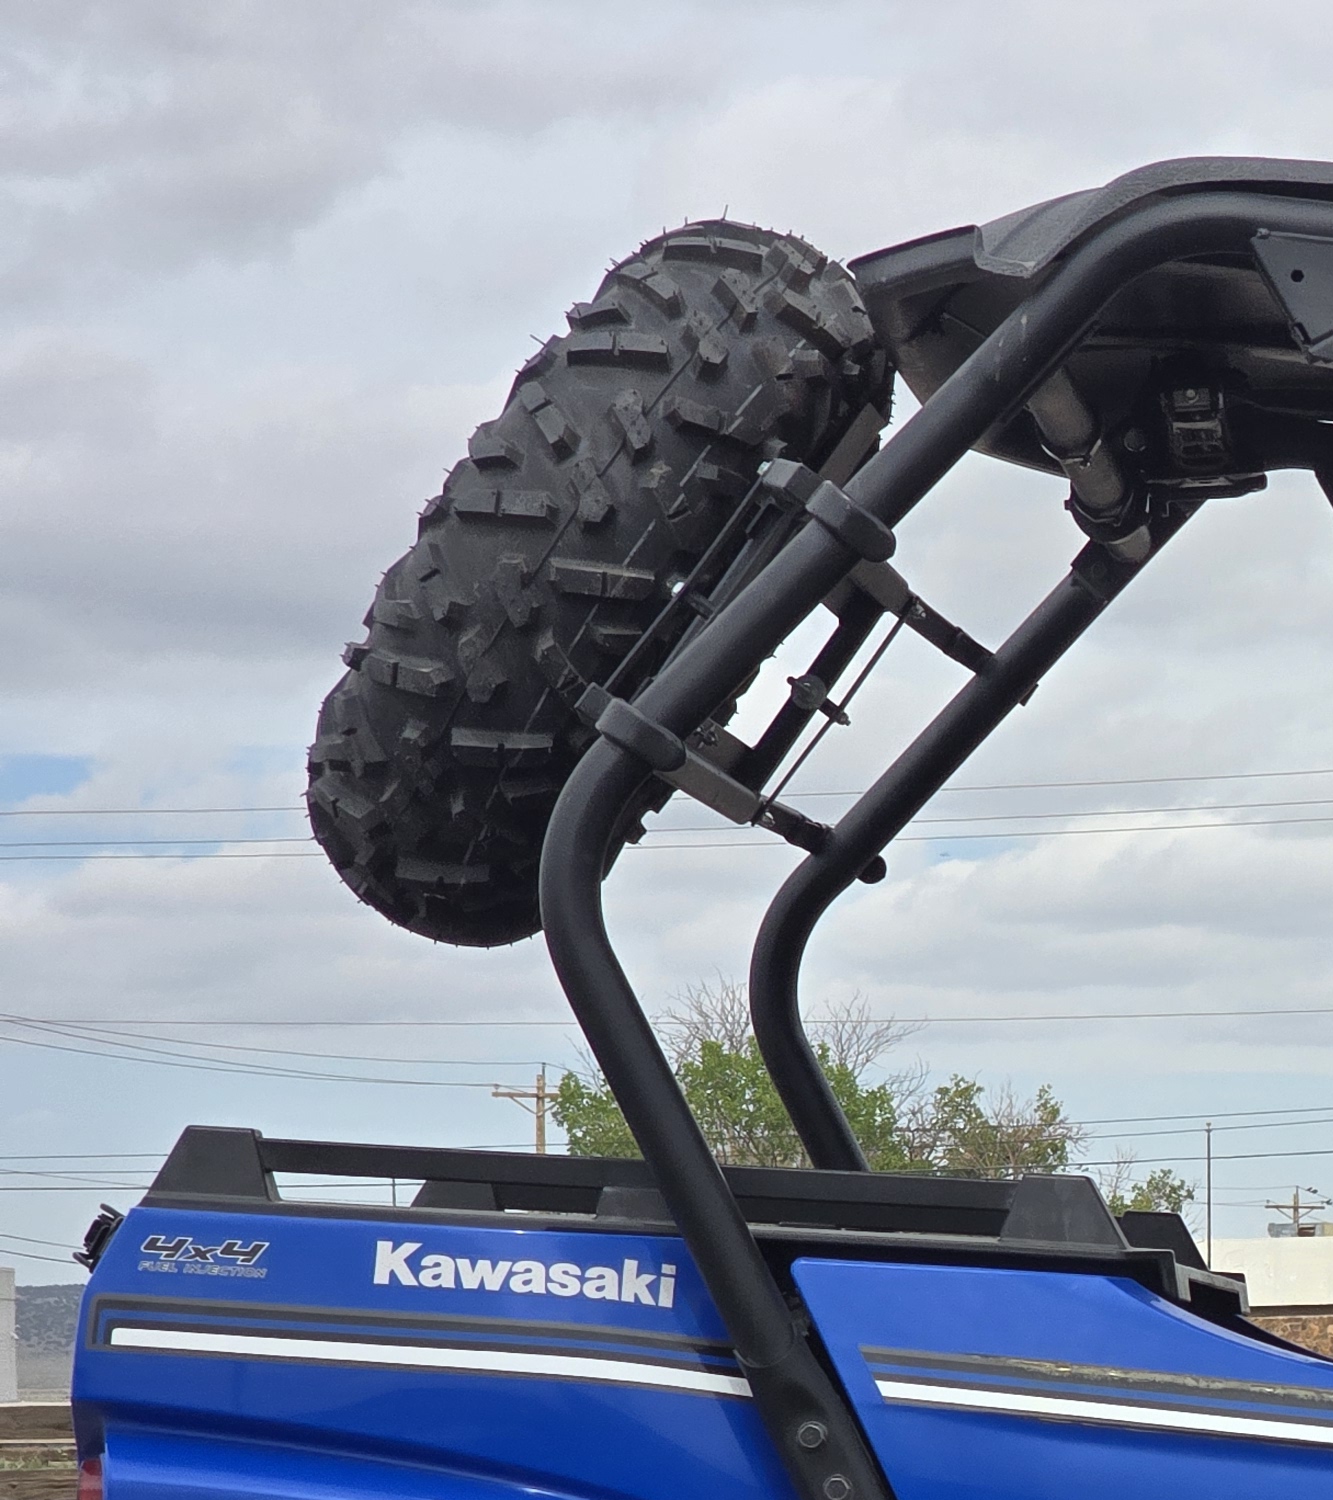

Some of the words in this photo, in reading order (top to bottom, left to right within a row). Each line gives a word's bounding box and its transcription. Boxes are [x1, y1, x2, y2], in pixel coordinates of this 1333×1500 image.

[137, 1260, 178, 1274] FUEL
[183, 1263, 268, 1279] INJECTION
[373, 1240, 678, 1309] Kawasaki
